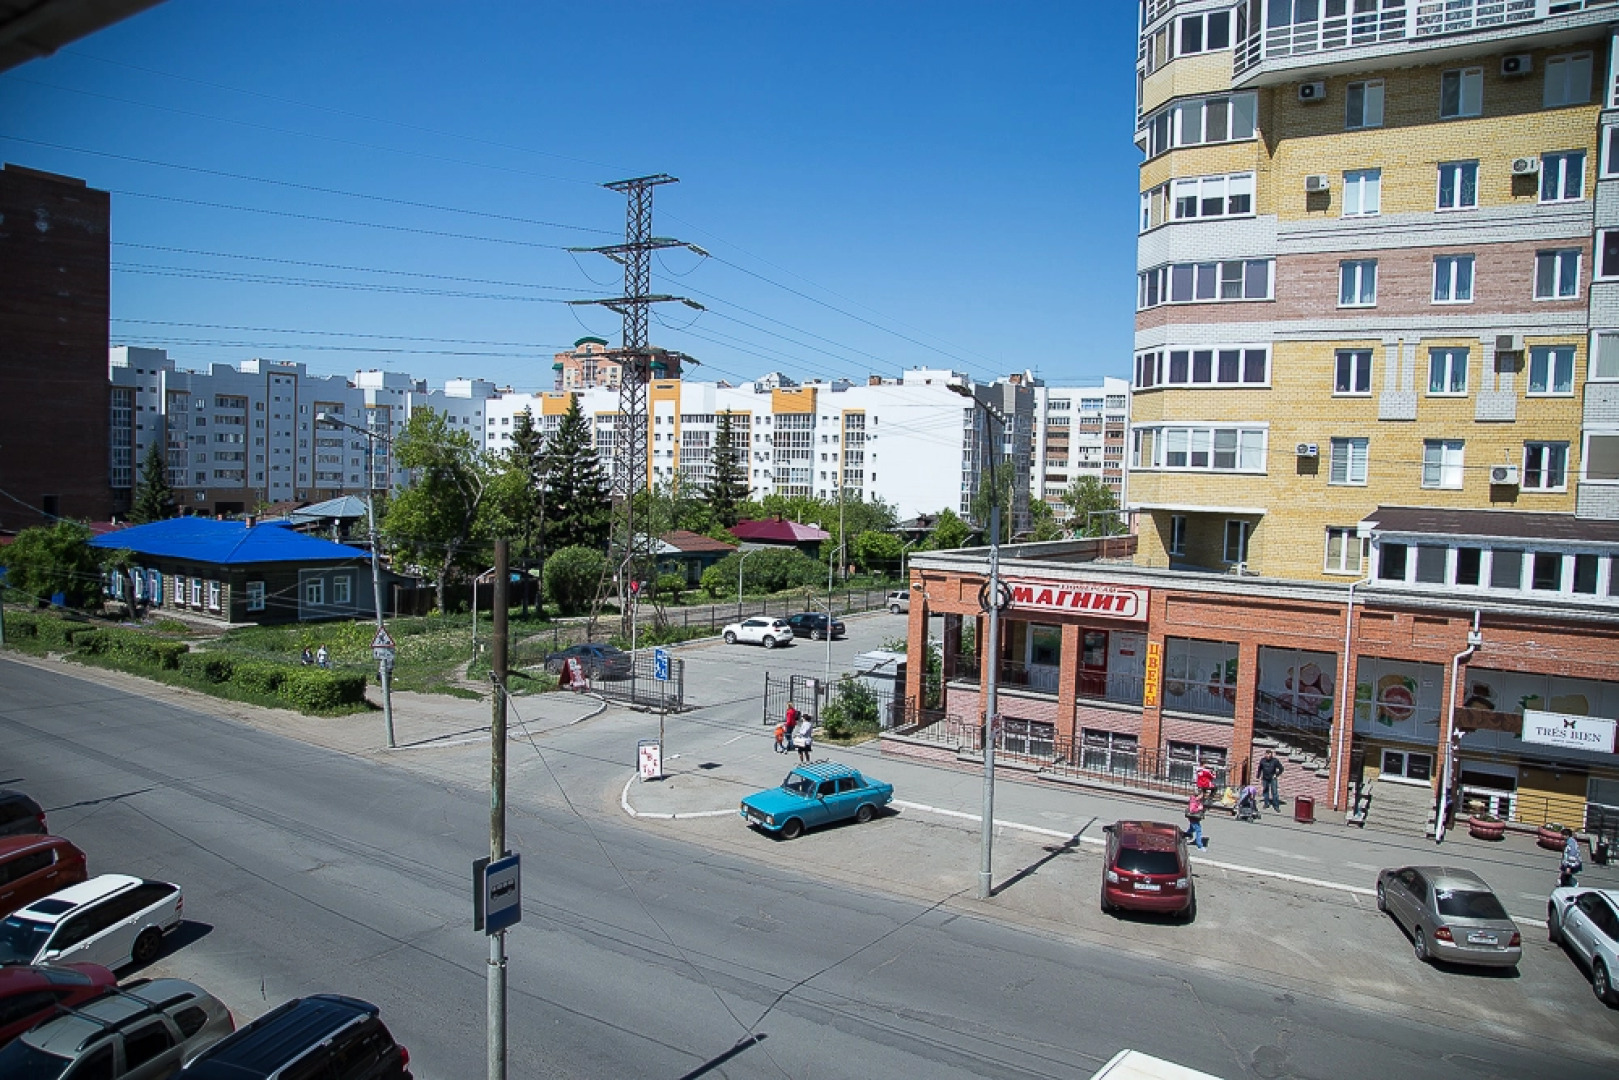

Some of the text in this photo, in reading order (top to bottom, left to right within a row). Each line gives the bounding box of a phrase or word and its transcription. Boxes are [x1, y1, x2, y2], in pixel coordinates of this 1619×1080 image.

[1013, 587, 1131, 611] МАГНИТ
[1145, 644, 1158, 706] ЦВЕТЫ
[1571, 732, 1601, 743] BIEN
